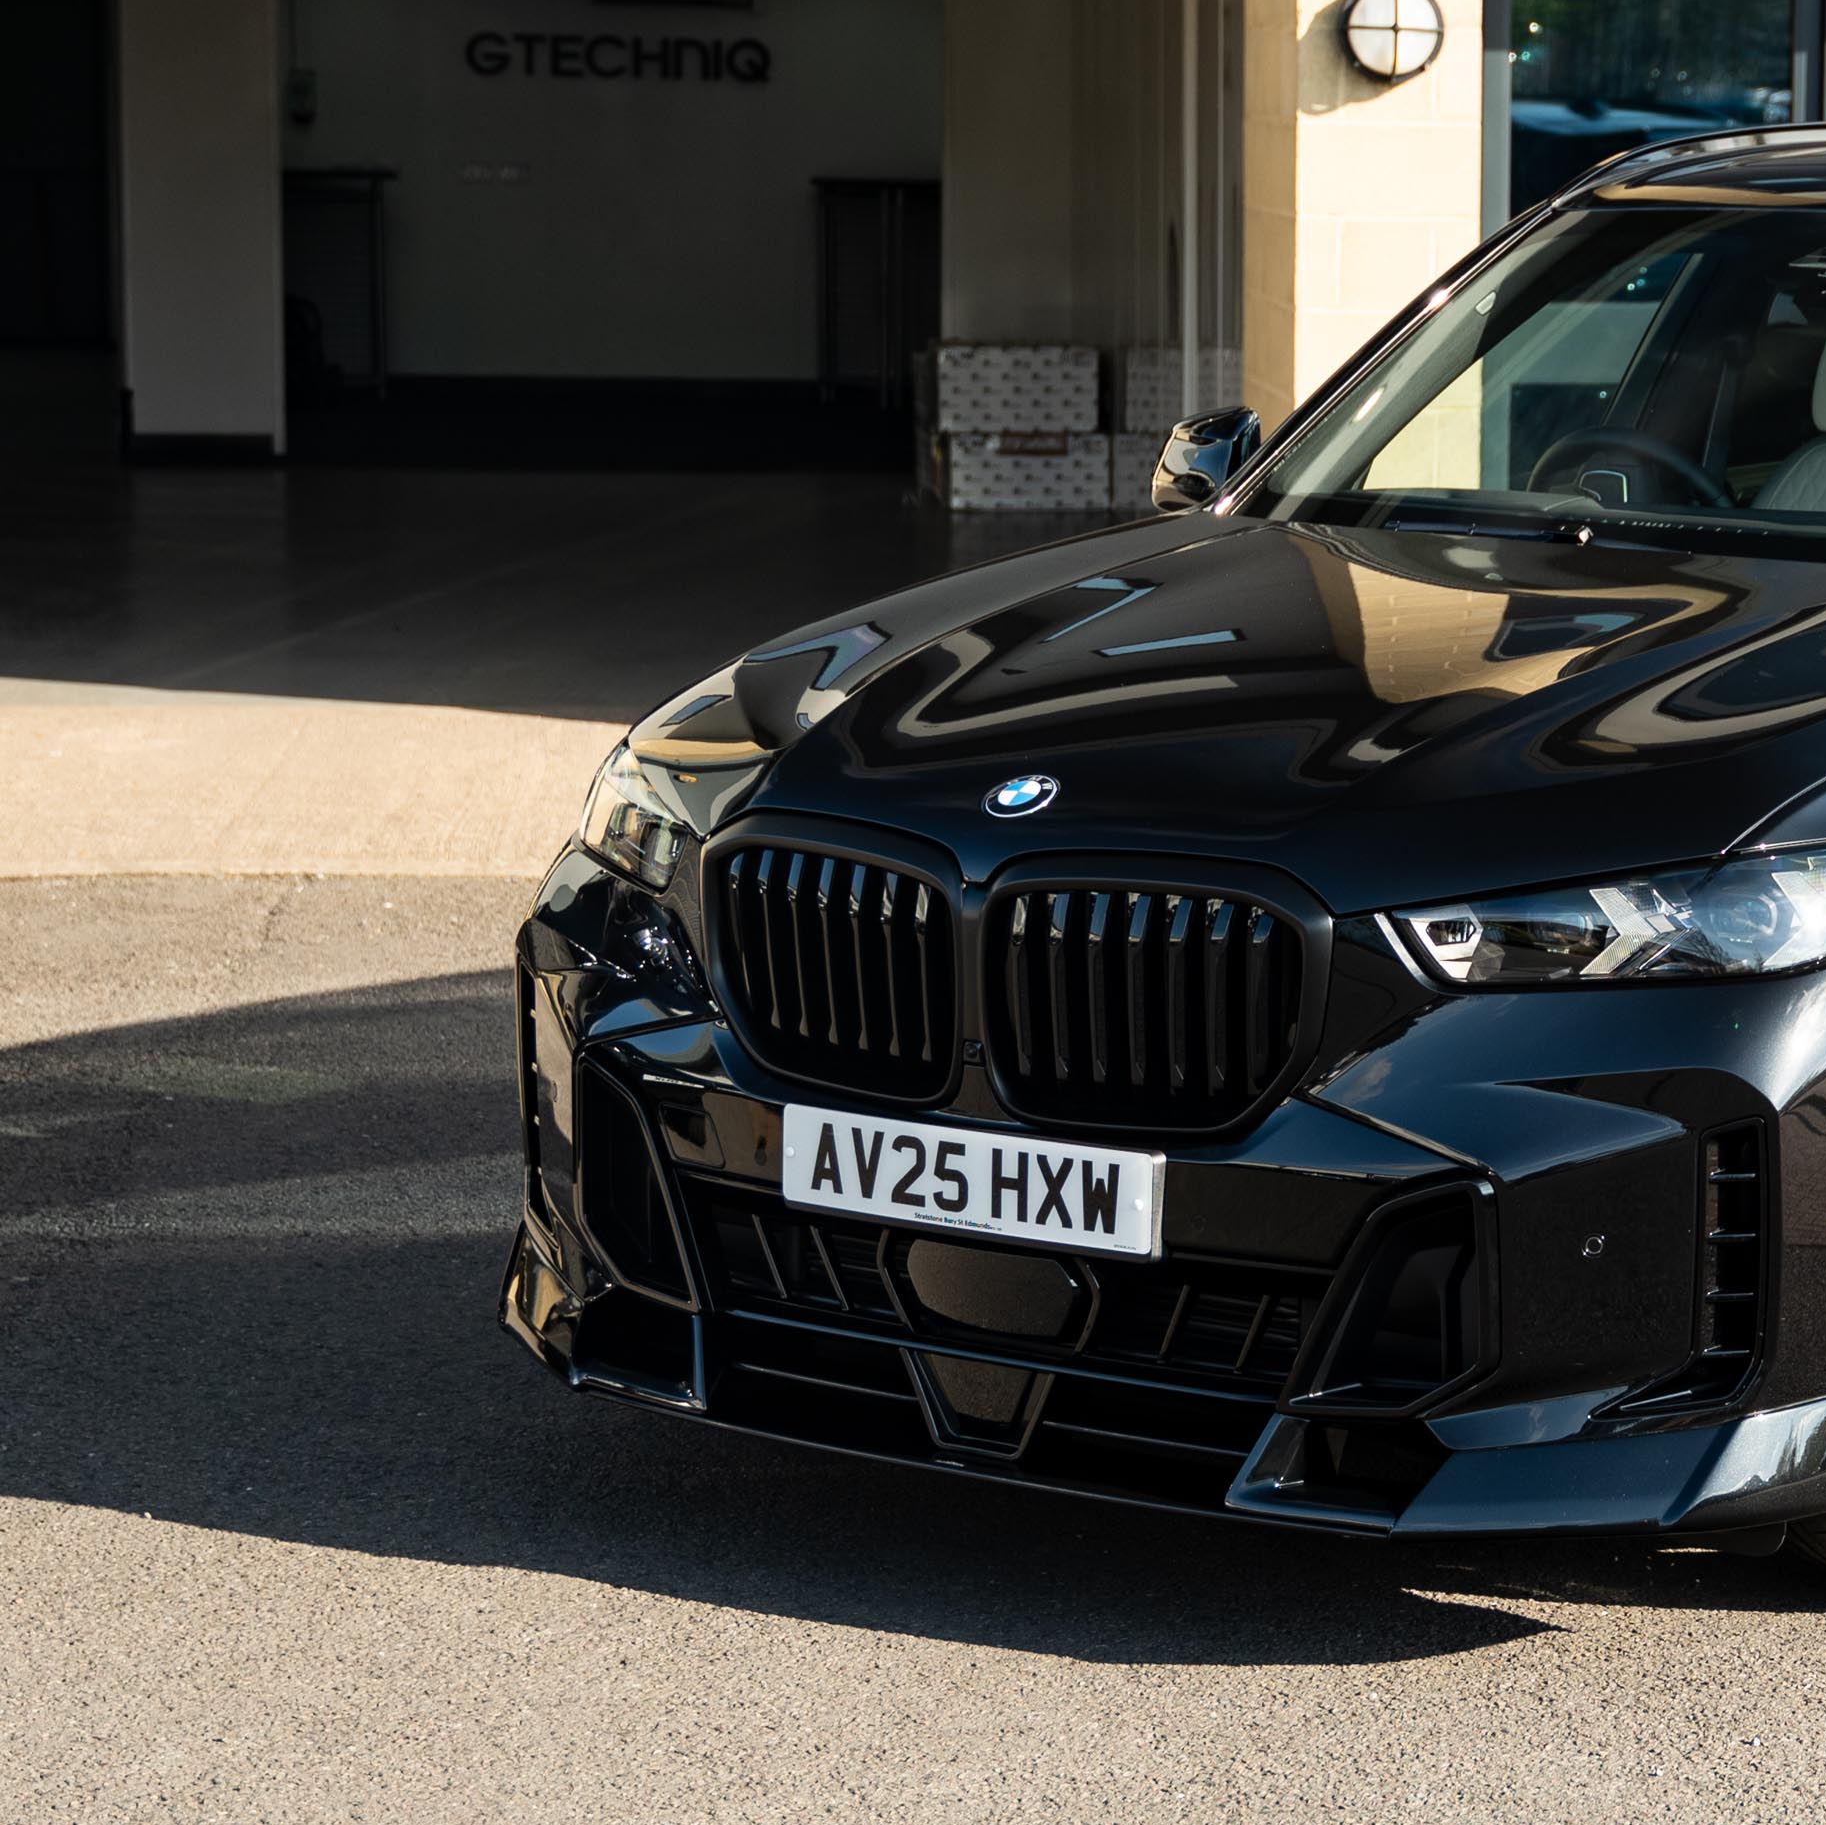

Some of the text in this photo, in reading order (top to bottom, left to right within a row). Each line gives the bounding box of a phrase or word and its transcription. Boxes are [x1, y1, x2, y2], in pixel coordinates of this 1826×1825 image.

[464, 31, 771, 83] GTECHNIQ
[810, 1122, 1121, 1235] AV25 HXW
[944, 1216, 957, 1226] Bury
[964, 1219, 991, 1230] Edmunds
